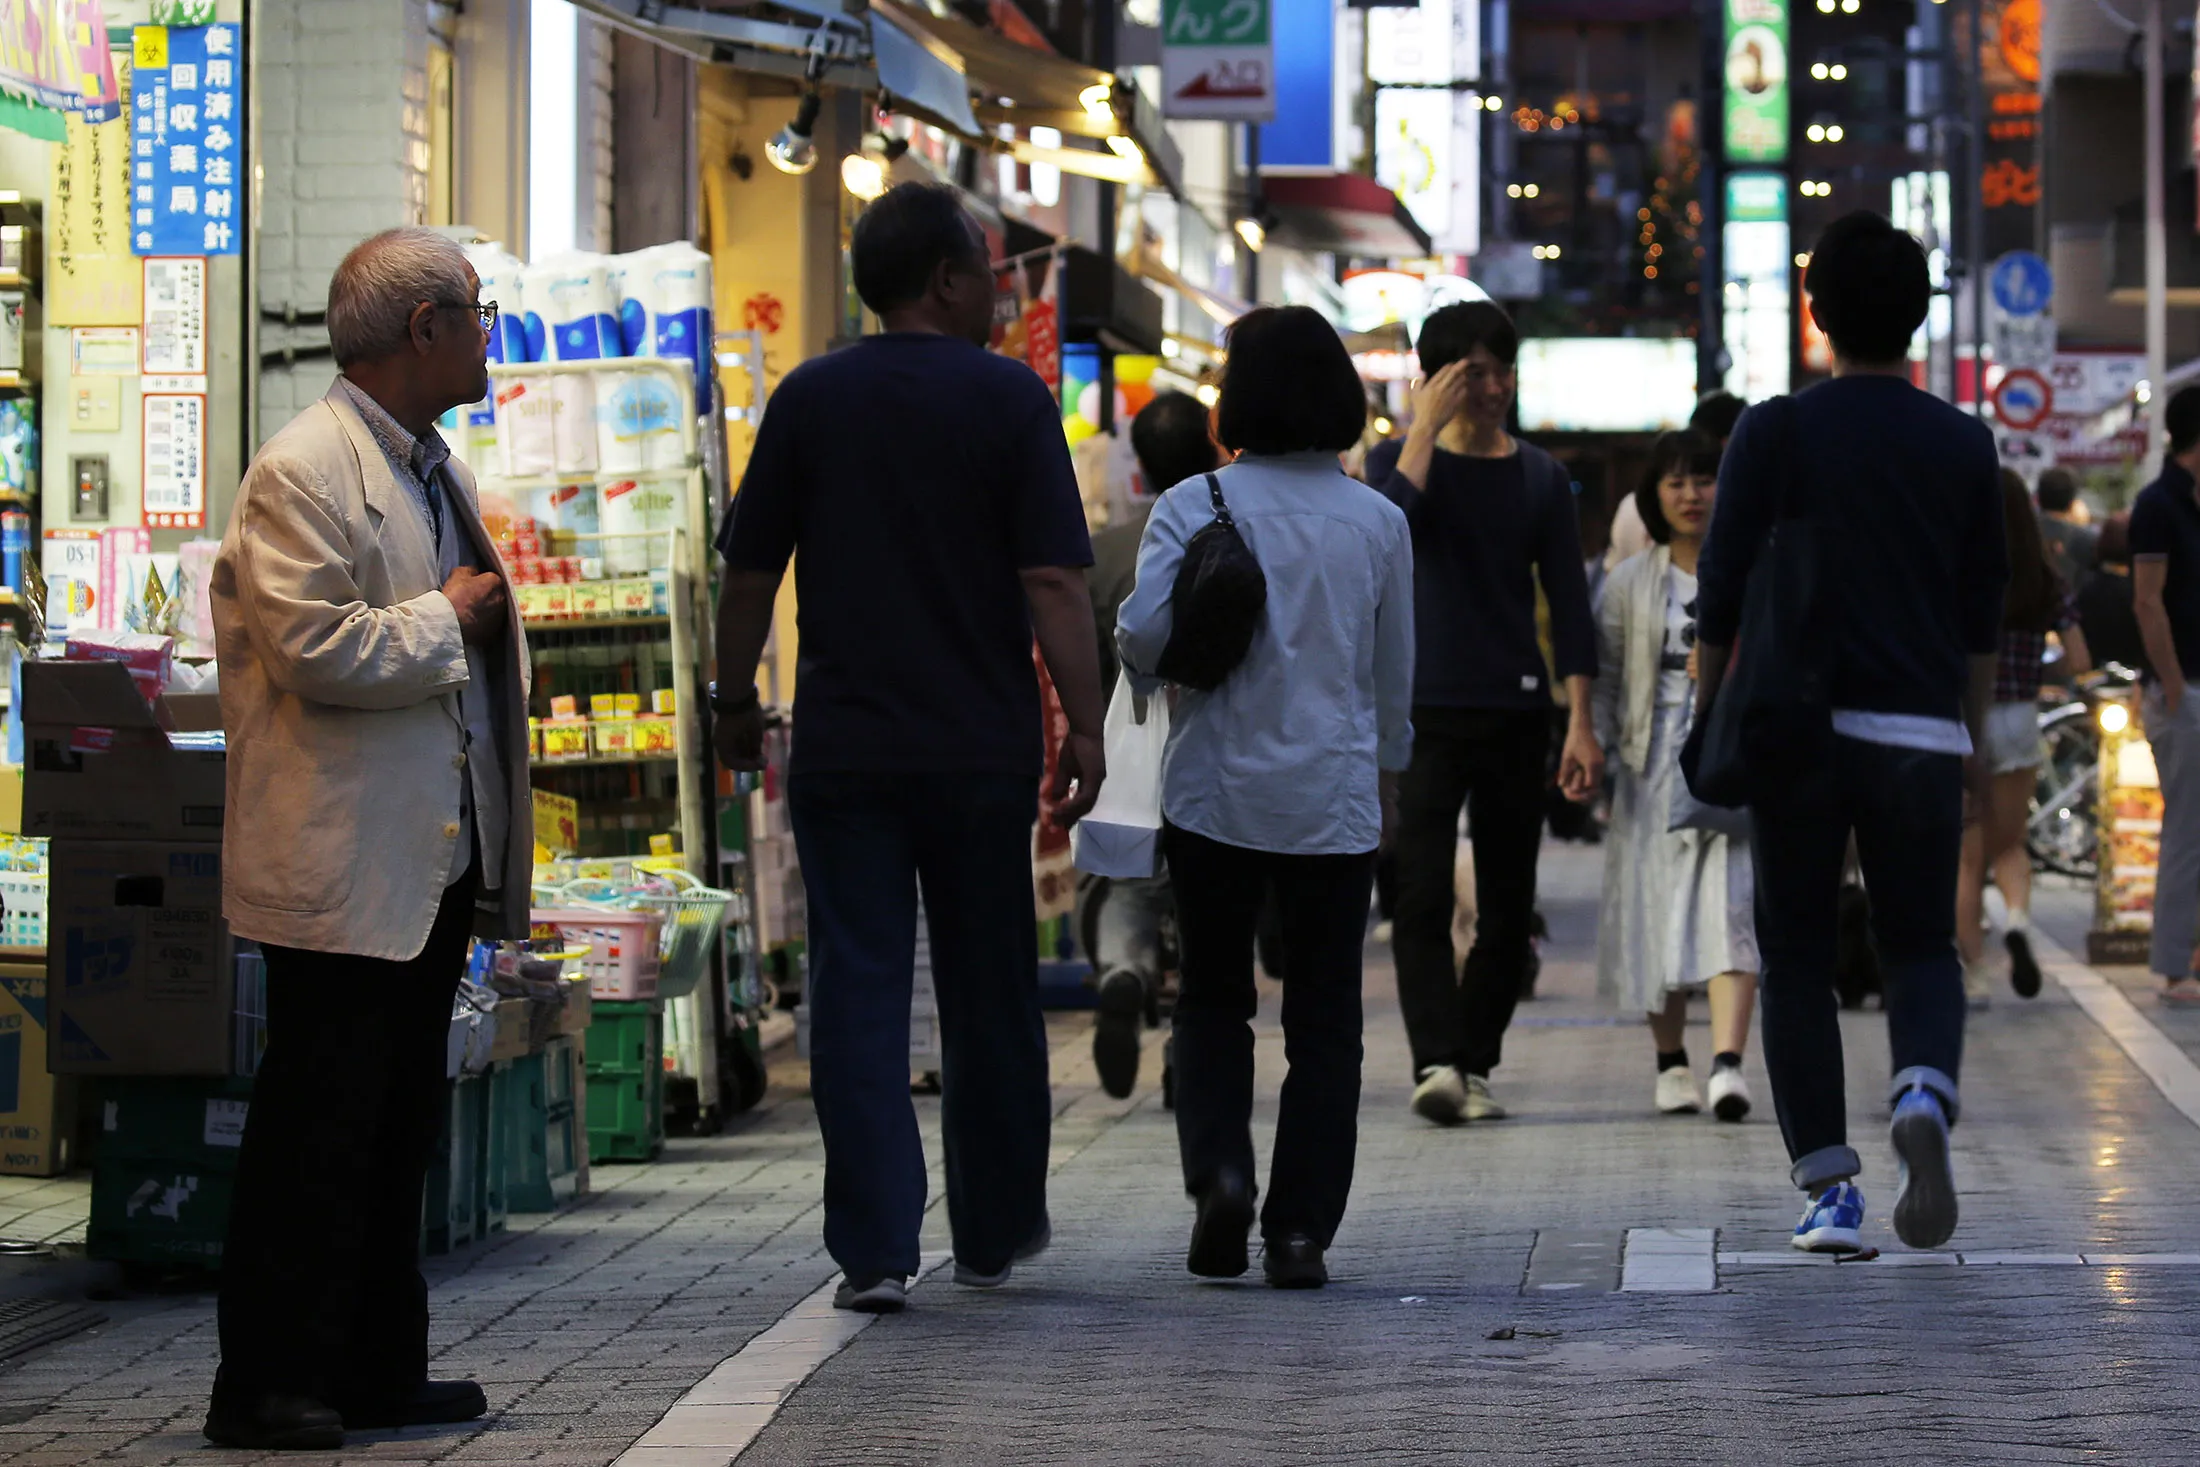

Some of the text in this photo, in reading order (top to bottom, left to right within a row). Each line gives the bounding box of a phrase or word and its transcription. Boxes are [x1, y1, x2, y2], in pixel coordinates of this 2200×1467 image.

[169, 63, 199, 215] 回収薬局
[203, 26, 234, 251] 使用済み注射針
